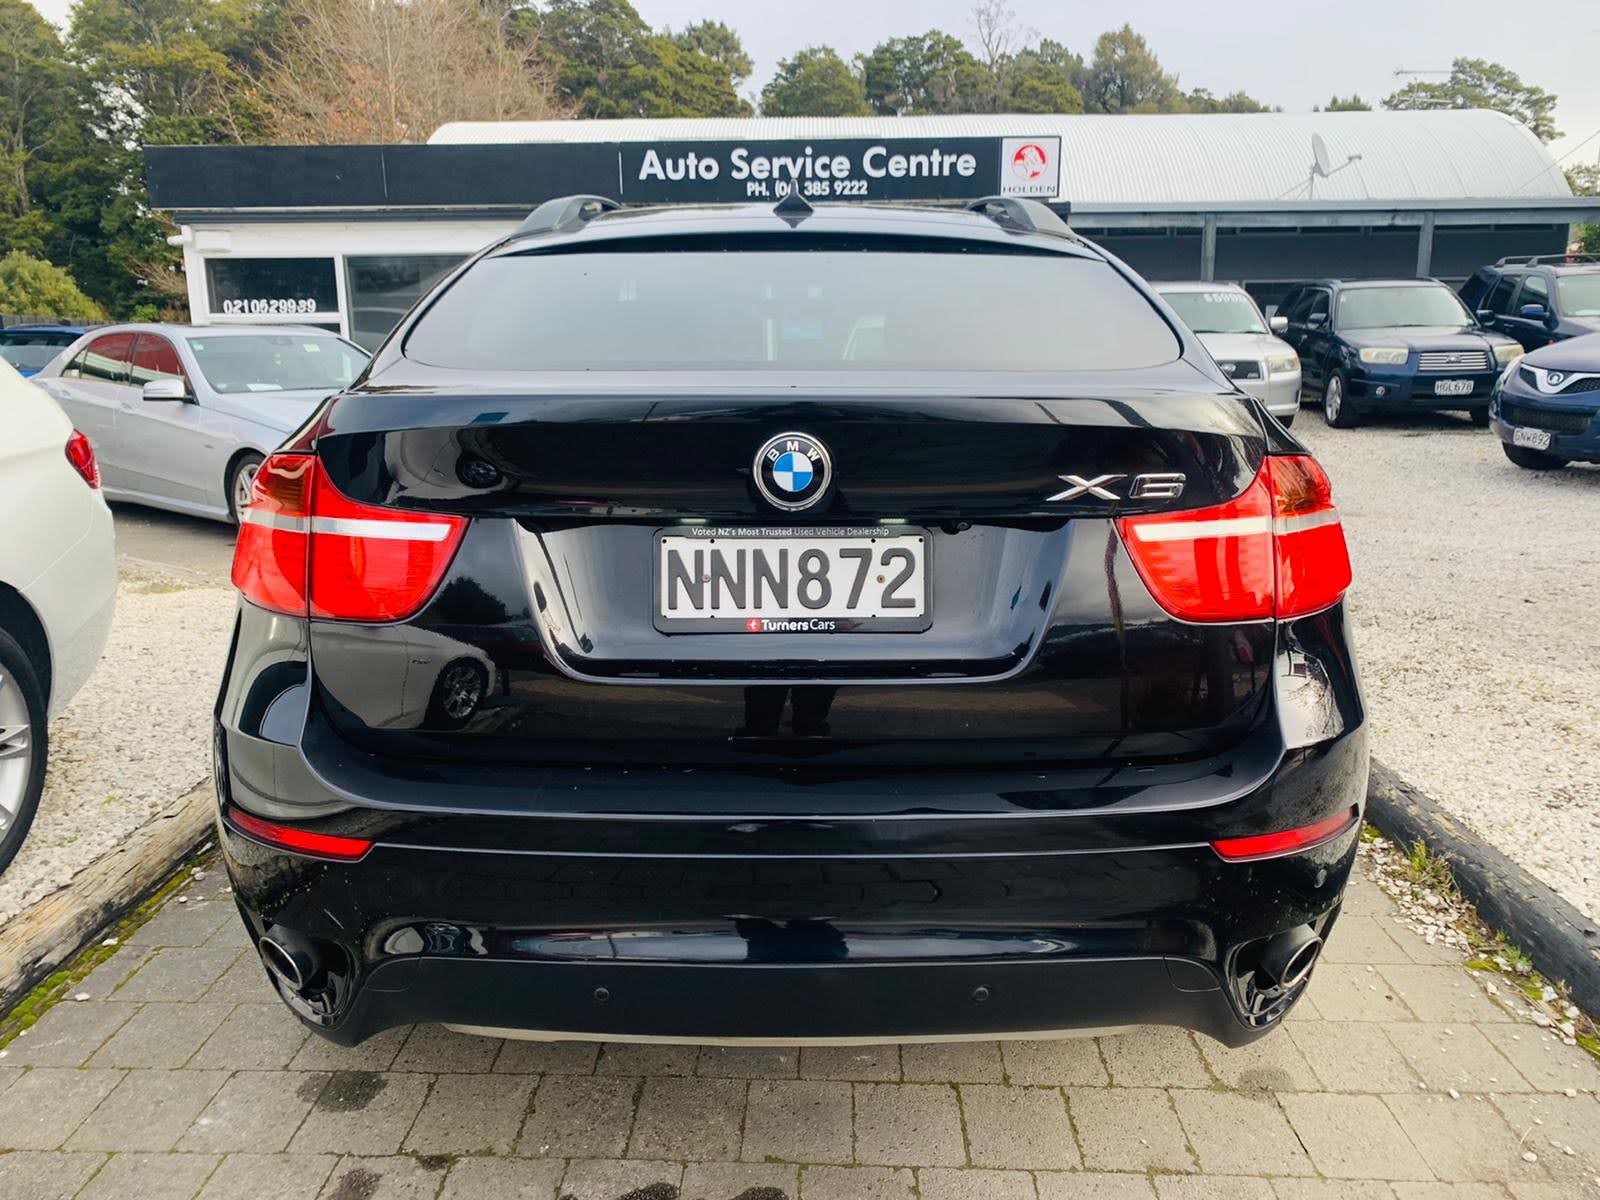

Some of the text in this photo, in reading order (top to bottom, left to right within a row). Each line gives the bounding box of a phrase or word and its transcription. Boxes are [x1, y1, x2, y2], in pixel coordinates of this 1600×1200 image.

[638, 145, 977, 181] Auto Service Centre
[746, 180, 770, 197] PH.
[803, 180, 831, 196] 385
[833, 179, 868, 196] 9222
[1002, 185, 1056, 193] HOLDEN
[766, 440, 821, 462] BMW
[1046, 472, 1187, 501] X6
[691, 527, 889, 537] Voted NZ's Most Trusted Used Vehicle Dealership
[667, 547, 917, 611] NNN872
